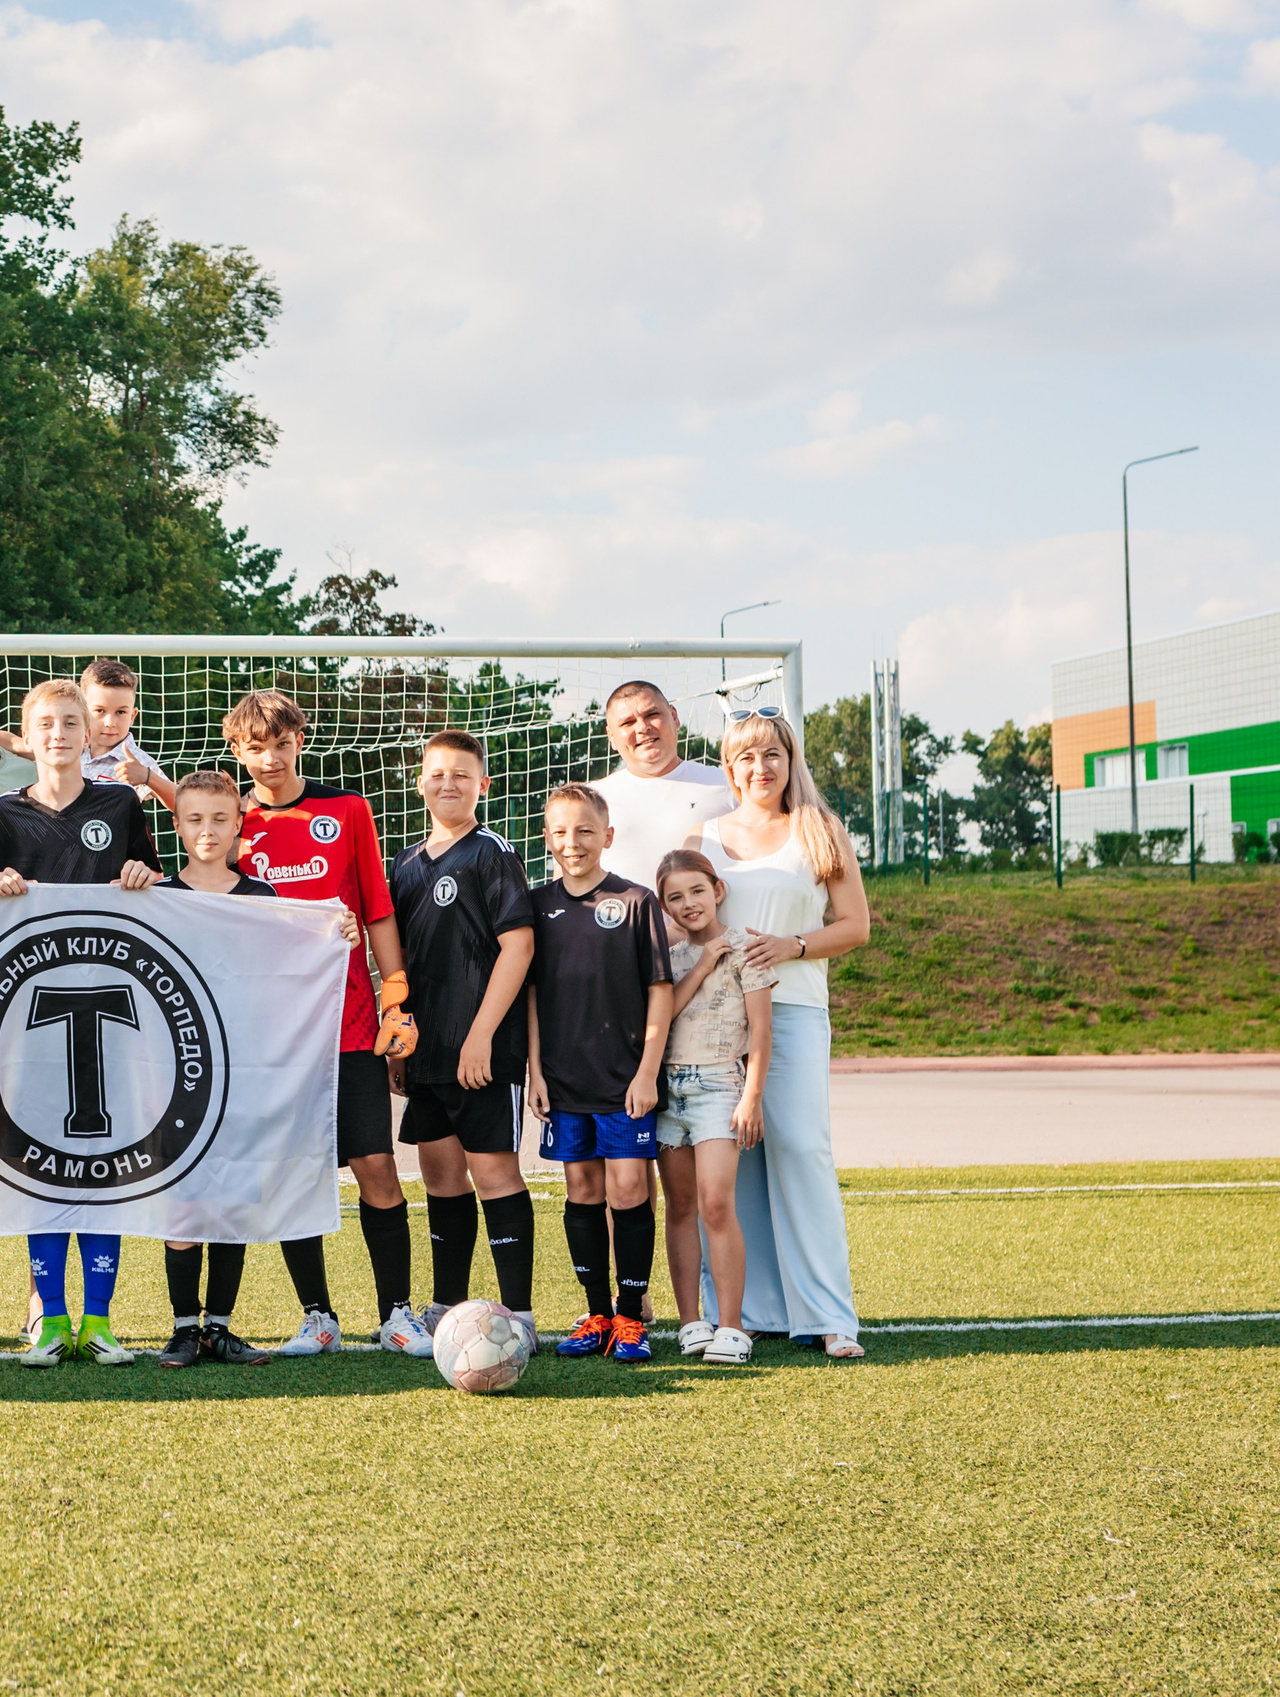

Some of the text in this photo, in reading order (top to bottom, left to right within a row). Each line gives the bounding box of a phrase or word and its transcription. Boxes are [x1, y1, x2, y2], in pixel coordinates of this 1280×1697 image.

[251, 852, 328, 884] Ровеньки
[66, 937, 132, 961] КЛУБ
[26, 984, 141, 1139] Т
[22, 1145, 153, 1179] РАМОНЬ
